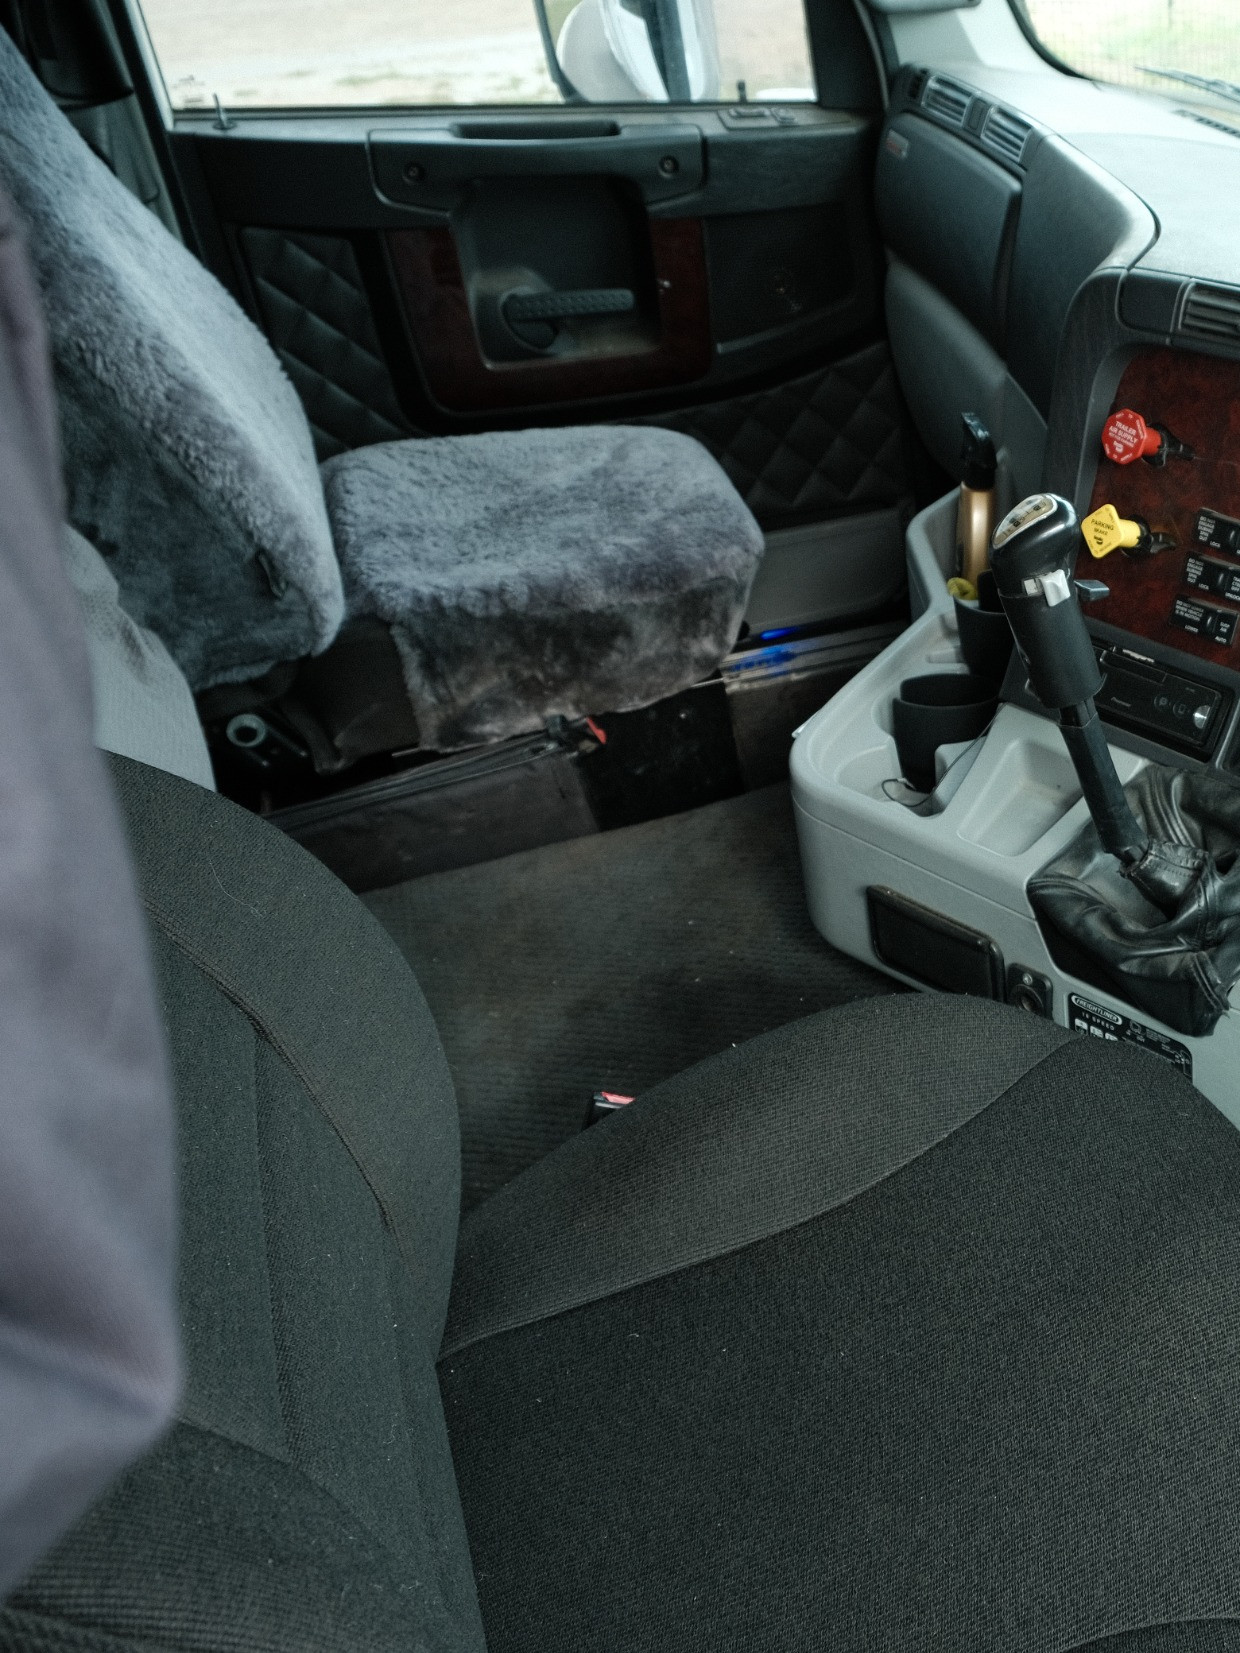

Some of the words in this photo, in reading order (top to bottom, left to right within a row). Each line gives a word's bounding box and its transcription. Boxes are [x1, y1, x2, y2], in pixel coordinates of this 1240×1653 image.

[1109, 425, 1119, 434] AIR
[1118, 429, 1138, 444] SUPPLY
[1116, 421, 1137, 436] TRAILER
[1091, 519, 1114, 531] PARKING
[1184, 625, 1199, 633] LOWER
[1214, 635, 1227, 643] AUTO
[1076, 998, 1118, 1022] FREIGHTLINER
[1092, 1016, 1115, 1031] SPEED
